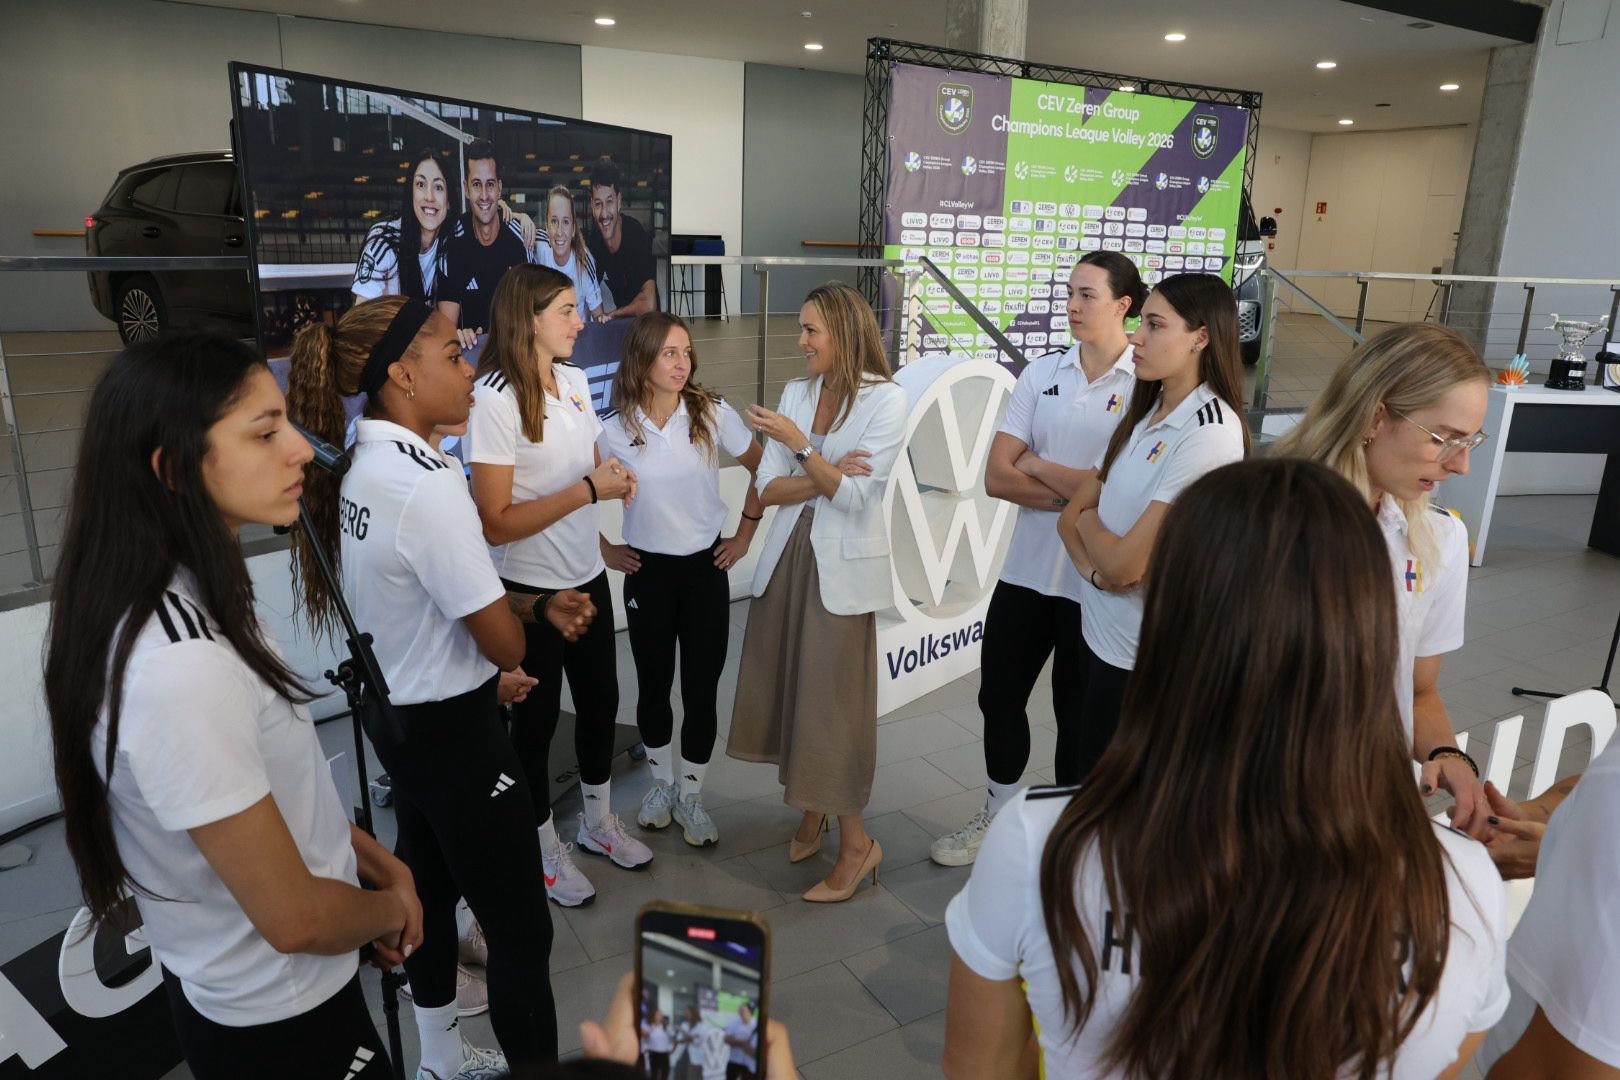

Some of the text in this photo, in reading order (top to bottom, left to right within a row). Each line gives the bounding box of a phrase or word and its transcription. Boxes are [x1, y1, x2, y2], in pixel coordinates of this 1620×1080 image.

[942, 87, 957, 96] CEV
[1038, 94, 1140, 124] CEV Zeren Group
[992, 115, 1063, 138] Champions
[1066, 123, 1109, 144] League
[1112, 128, 1146, 149] Volley
[1147, 132, 1175, 149] 2026
[940, 200, 975, 209] #CLVolleyW
